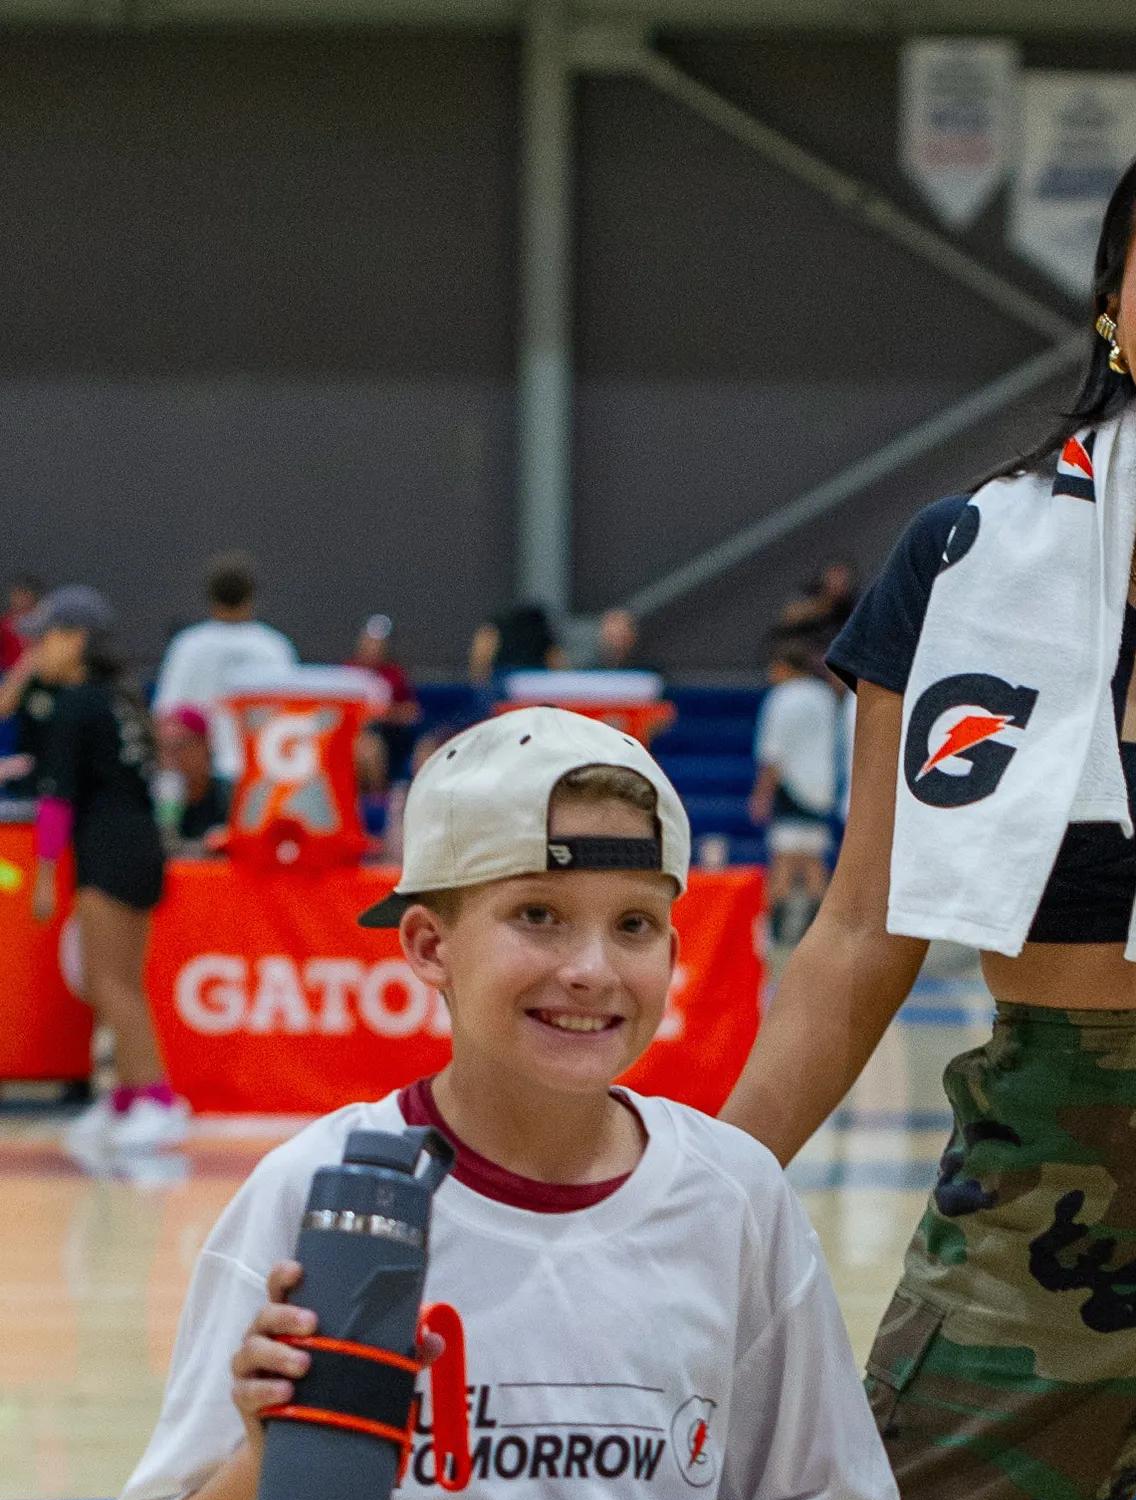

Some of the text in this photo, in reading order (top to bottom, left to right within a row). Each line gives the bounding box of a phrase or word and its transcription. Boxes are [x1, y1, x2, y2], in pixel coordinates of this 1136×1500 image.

[259, 714, 322, 780] G
[903, 672, 1040, 809] G
[410, 1433, 666, 1487] OMORROW
